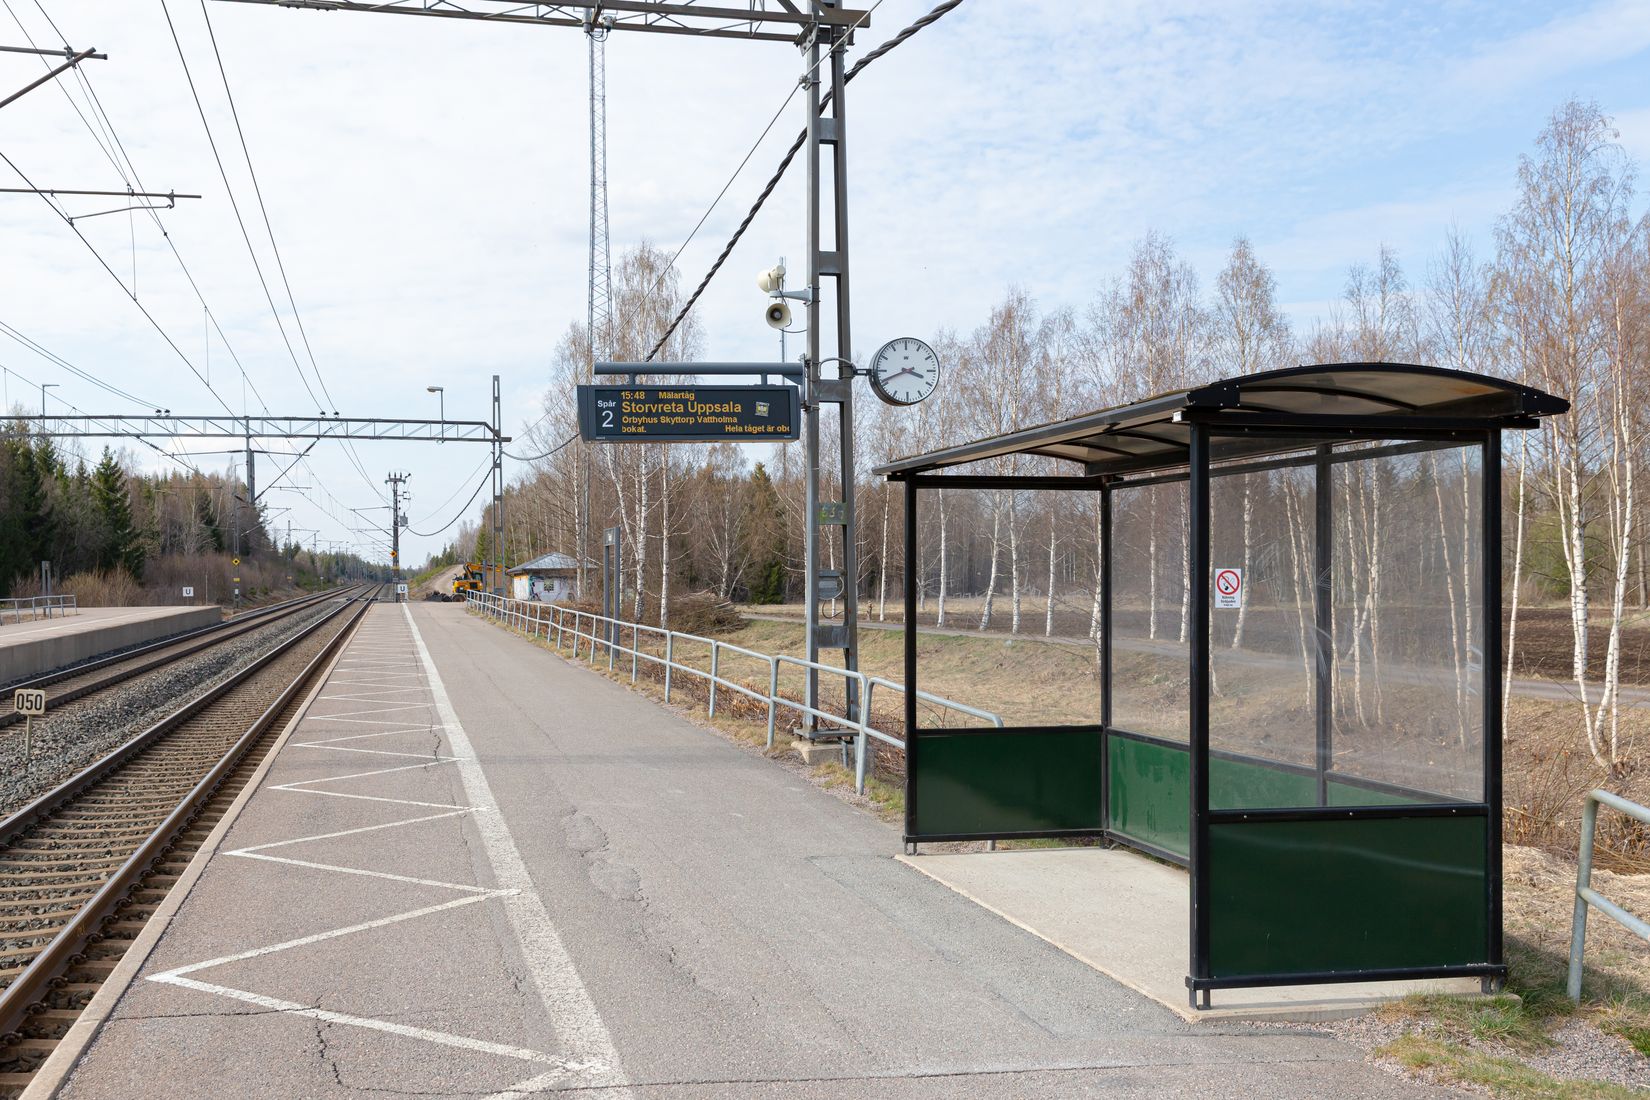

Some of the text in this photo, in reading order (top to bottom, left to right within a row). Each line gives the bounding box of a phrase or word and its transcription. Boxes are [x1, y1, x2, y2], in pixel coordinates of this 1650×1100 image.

[621, 391, 695, 400] 15:48 Mälartåg
[597, 400, 617, 408] Spår
[622, 401, 742, 415] Storvreta Uppsala
[602, 410, 614, 428] 2
[660, 416, 694, 424] Skyttorp
[744, 424, 765, 434] tåget
[16, 693, 42, 710] 050
